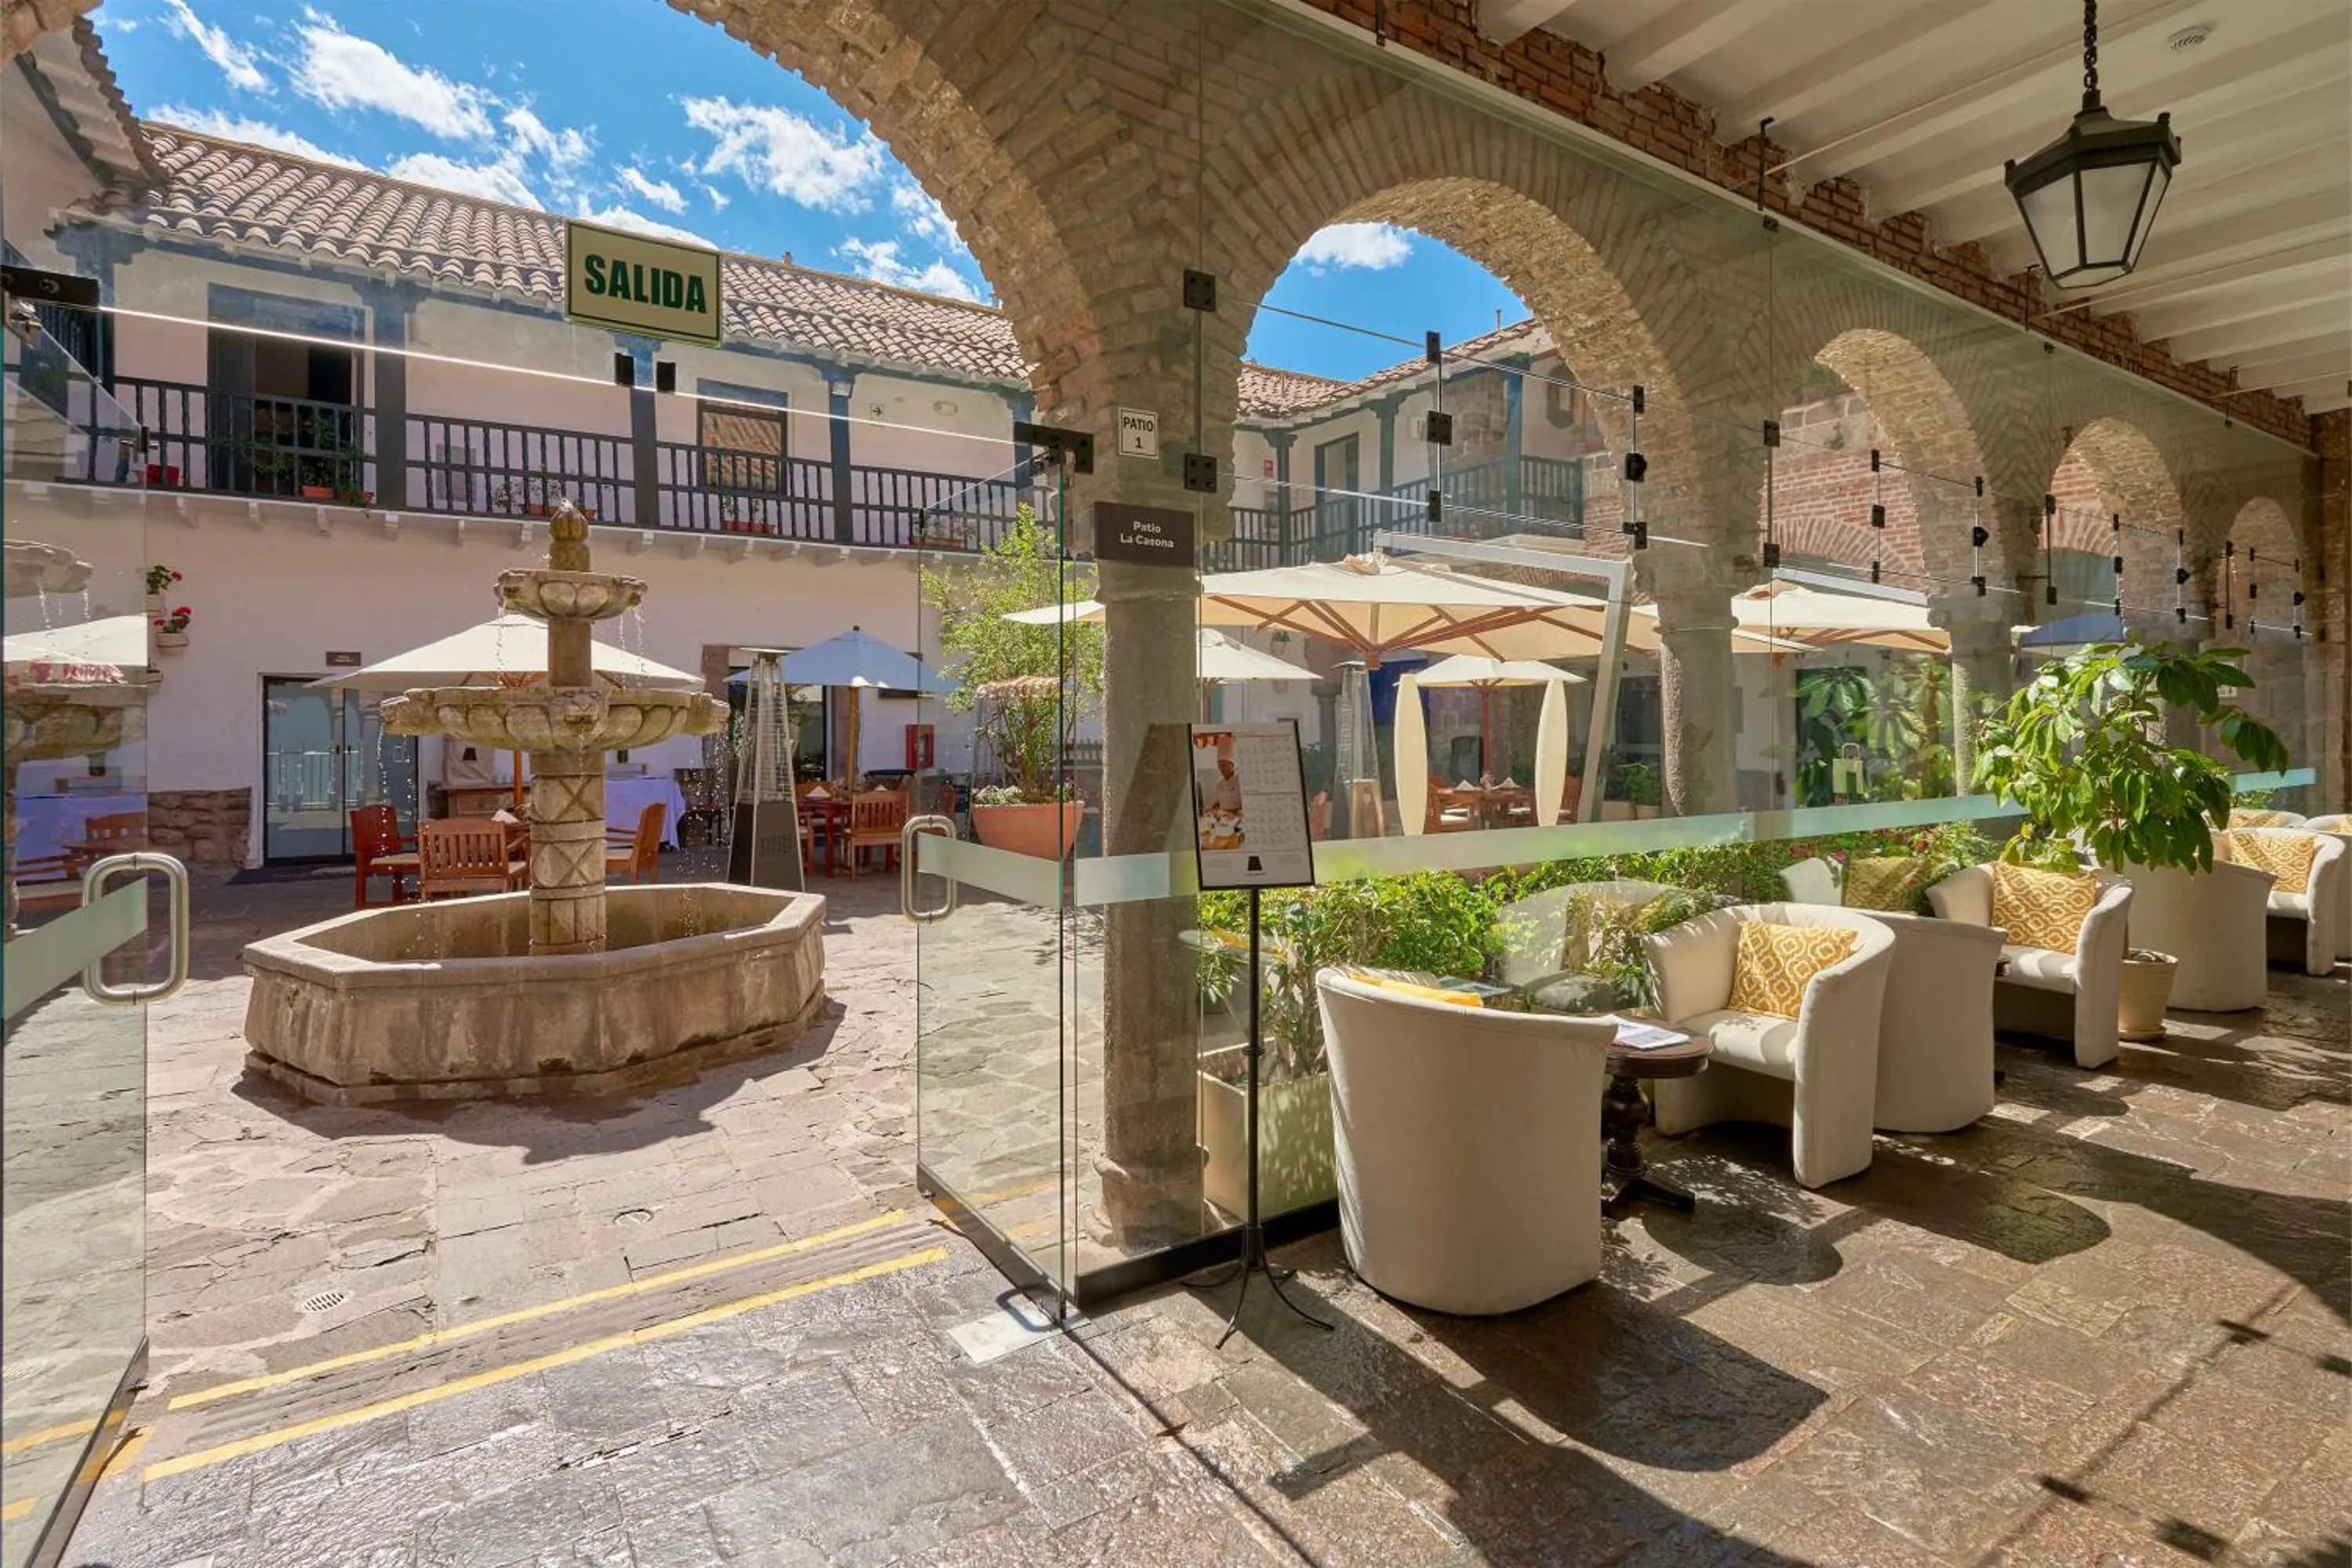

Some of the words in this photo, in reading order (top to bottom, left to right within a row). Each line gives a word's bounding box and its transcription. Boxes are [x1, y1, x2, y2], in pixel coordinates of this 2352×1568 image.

[584, 254, 707, 314] SALIDA
[1123, 416, 1153, 432] PATIO
[1134, 437, 1142, 449] 1
[1133, 521, 1161, 534] Patio
[1120, 533, 1133, 543] La
[1135, 535, 1174, 548] Casona
